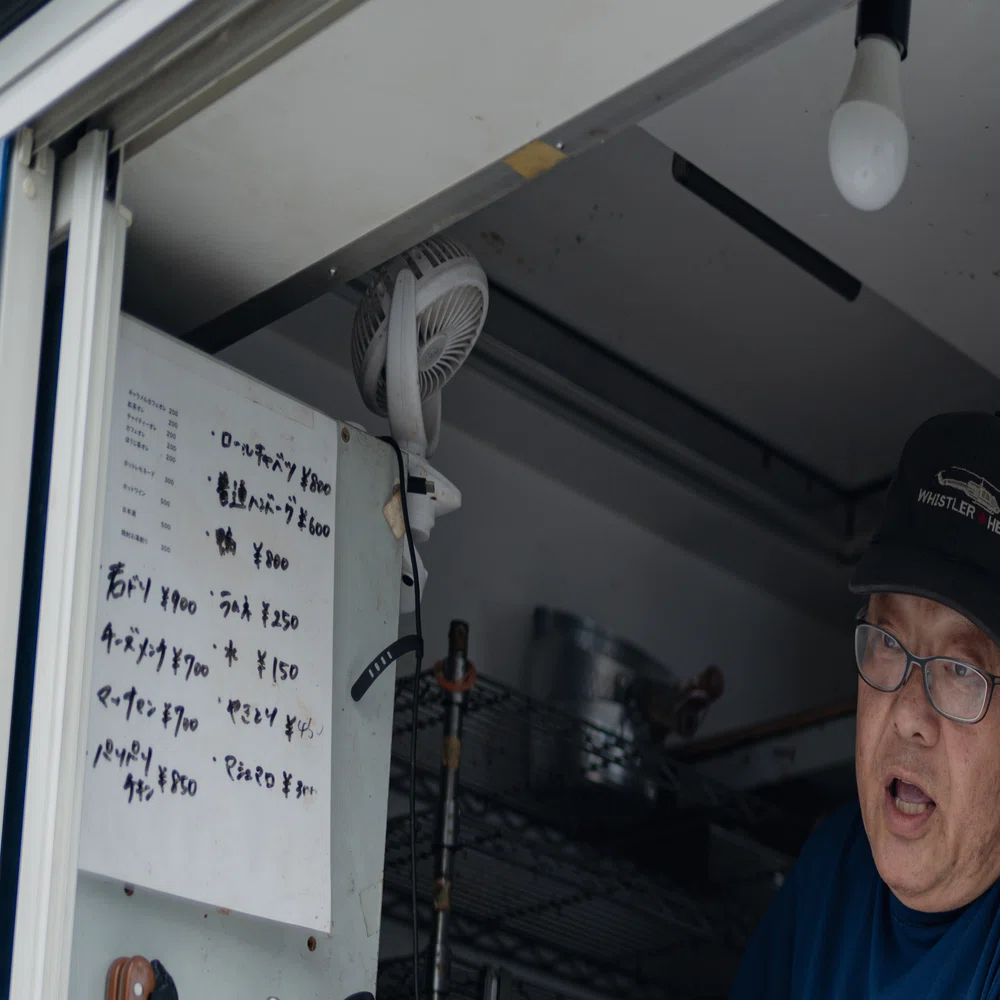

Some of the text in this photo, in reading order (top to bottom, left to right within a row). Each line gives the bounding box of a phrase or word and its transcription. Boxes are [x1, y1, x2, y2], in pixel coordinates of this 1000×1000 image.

[168, 408, 179, 417] 200
[168, 420, 179, 429] 200
[166, 430, 177, 440] 200
[166, 442, 177, 452] 200
[166, 454, 177, 464] 200
[300, 466, 332, 496] ¥800
[917, 488, 976, 520] WHISTLER
[160, 521, 171, 531] 500
[297, 507, 331, 538] ¥600
[160, 544, 171, 553] 300
[253, 541, 289, 571] ¥800
[161, 586, 197, 615] ¥900
[262, 601, 299, 630] ¥250
[172, 646, 209, 681] ¥700
[257, 650, 299, 683] ¥150
[162, 702, 199, 737] ¥700
[158, 765, 198, 798] ¥850
